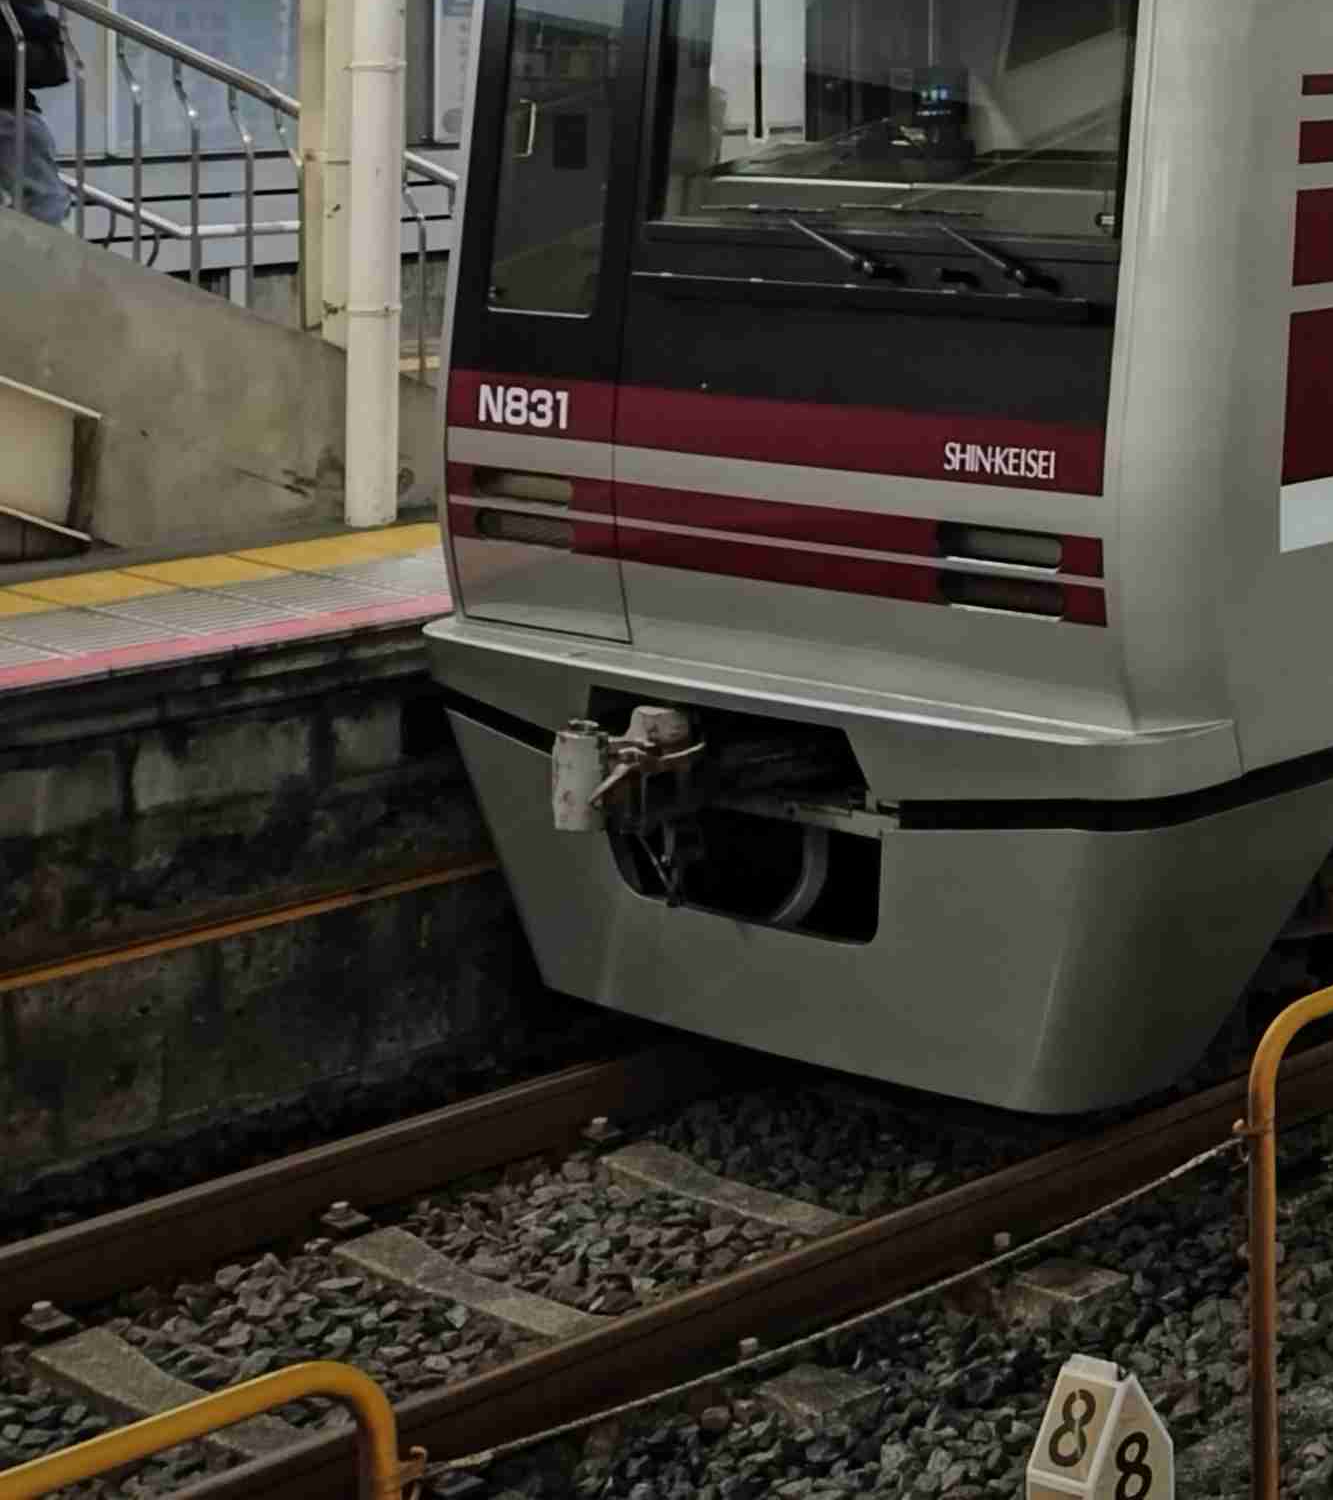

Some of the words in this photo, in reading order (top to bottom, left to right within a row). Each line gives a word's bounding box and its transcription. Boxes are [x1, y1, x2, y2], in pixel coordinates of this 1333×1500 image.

[478, 384, 569, 431] N831
[1048, 1388, 1097, 1468] 8
[1115, 1430, 1153, 1500] 8
